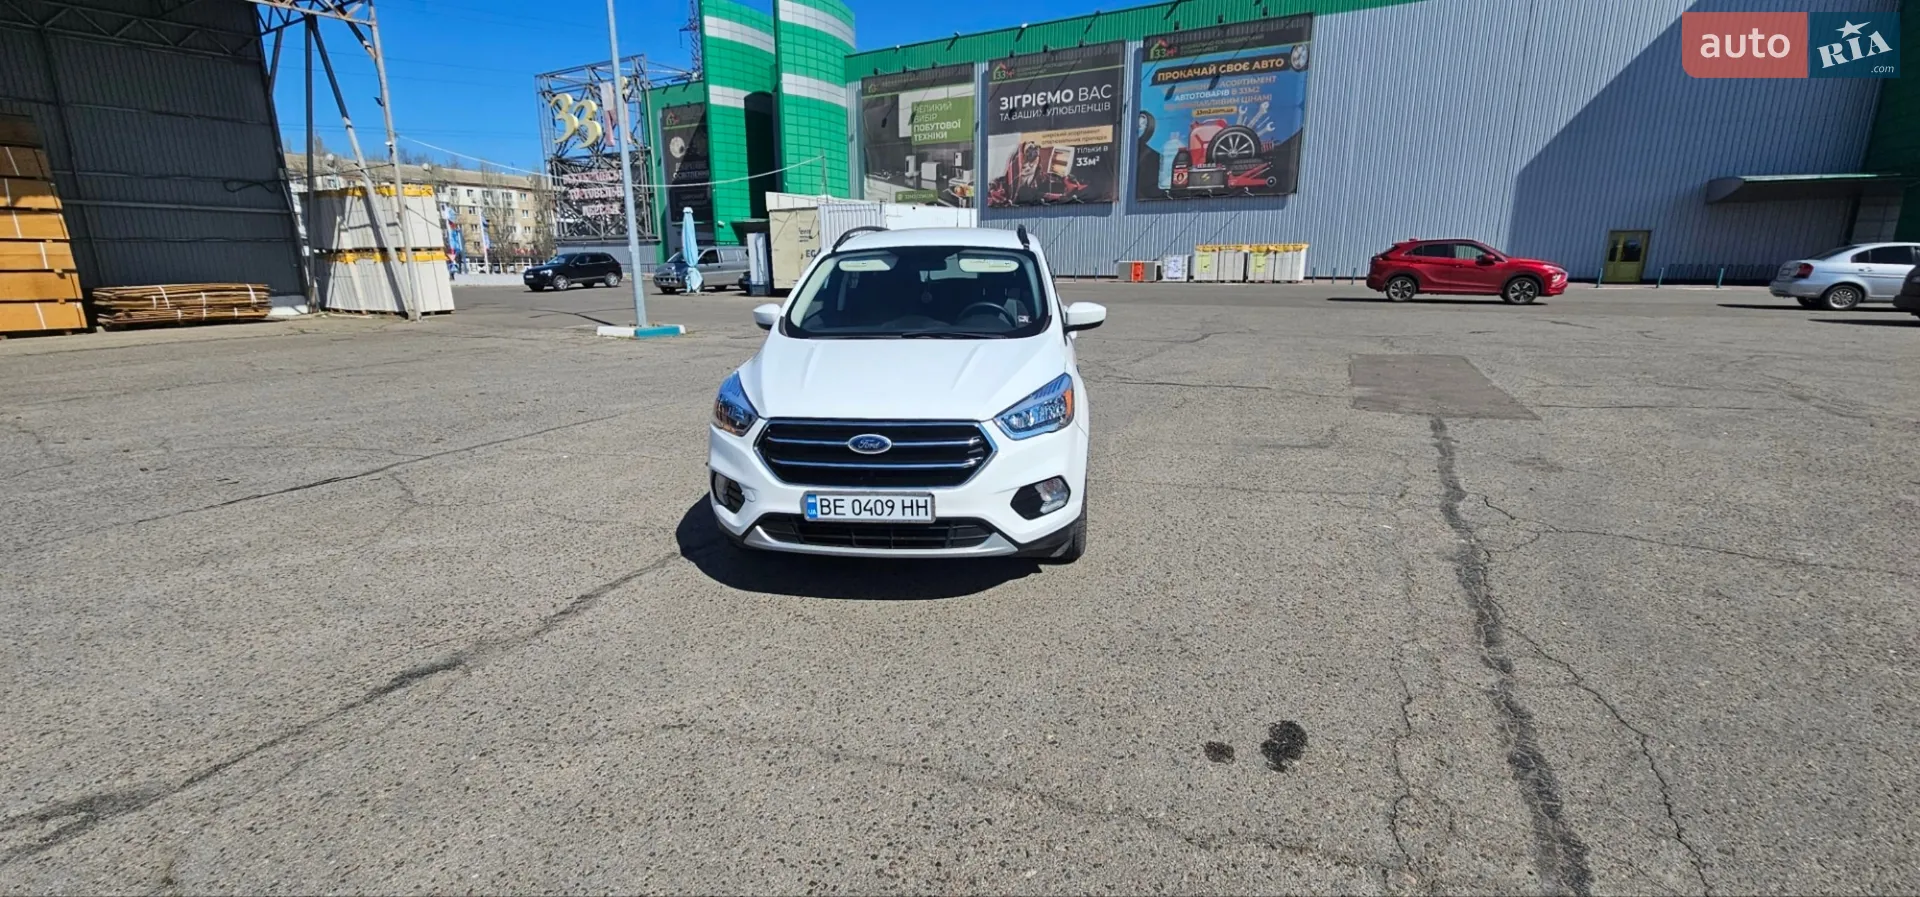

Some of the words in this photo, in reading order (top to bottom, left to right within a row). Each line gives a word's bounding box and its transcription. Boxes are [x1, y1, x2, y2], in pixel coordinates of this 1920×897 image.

[1157, 64, 1217, 81] ПРОКАЧАЙ
[1218, 61, 1250, 74] СВОЄ
[1252, 58, 1284, 70] АВТО
[1000, 89, 1074, 110] ЗІГРІЄМО
[1078, 84, 1112, 102] ВАС
[1174, 89, 1230, 102] АВТОТОВАРІВ
[1045, 102, 1111, 117] УЛЮБЛЕНЦІВ
[914, 113, 938, 124] ВИБІР
[913, 119, 962, 133] ПОБУТОВОЇ
[913, 131, 948, 142] ТЕХНІКИ
[857, 438, 881, 450] Ford
[807, 508, 817, 516] UA
[819, 497, 847, 516] BE
[851, 498, 896, 517] 0409
[901, 498, 929, 517] HH
